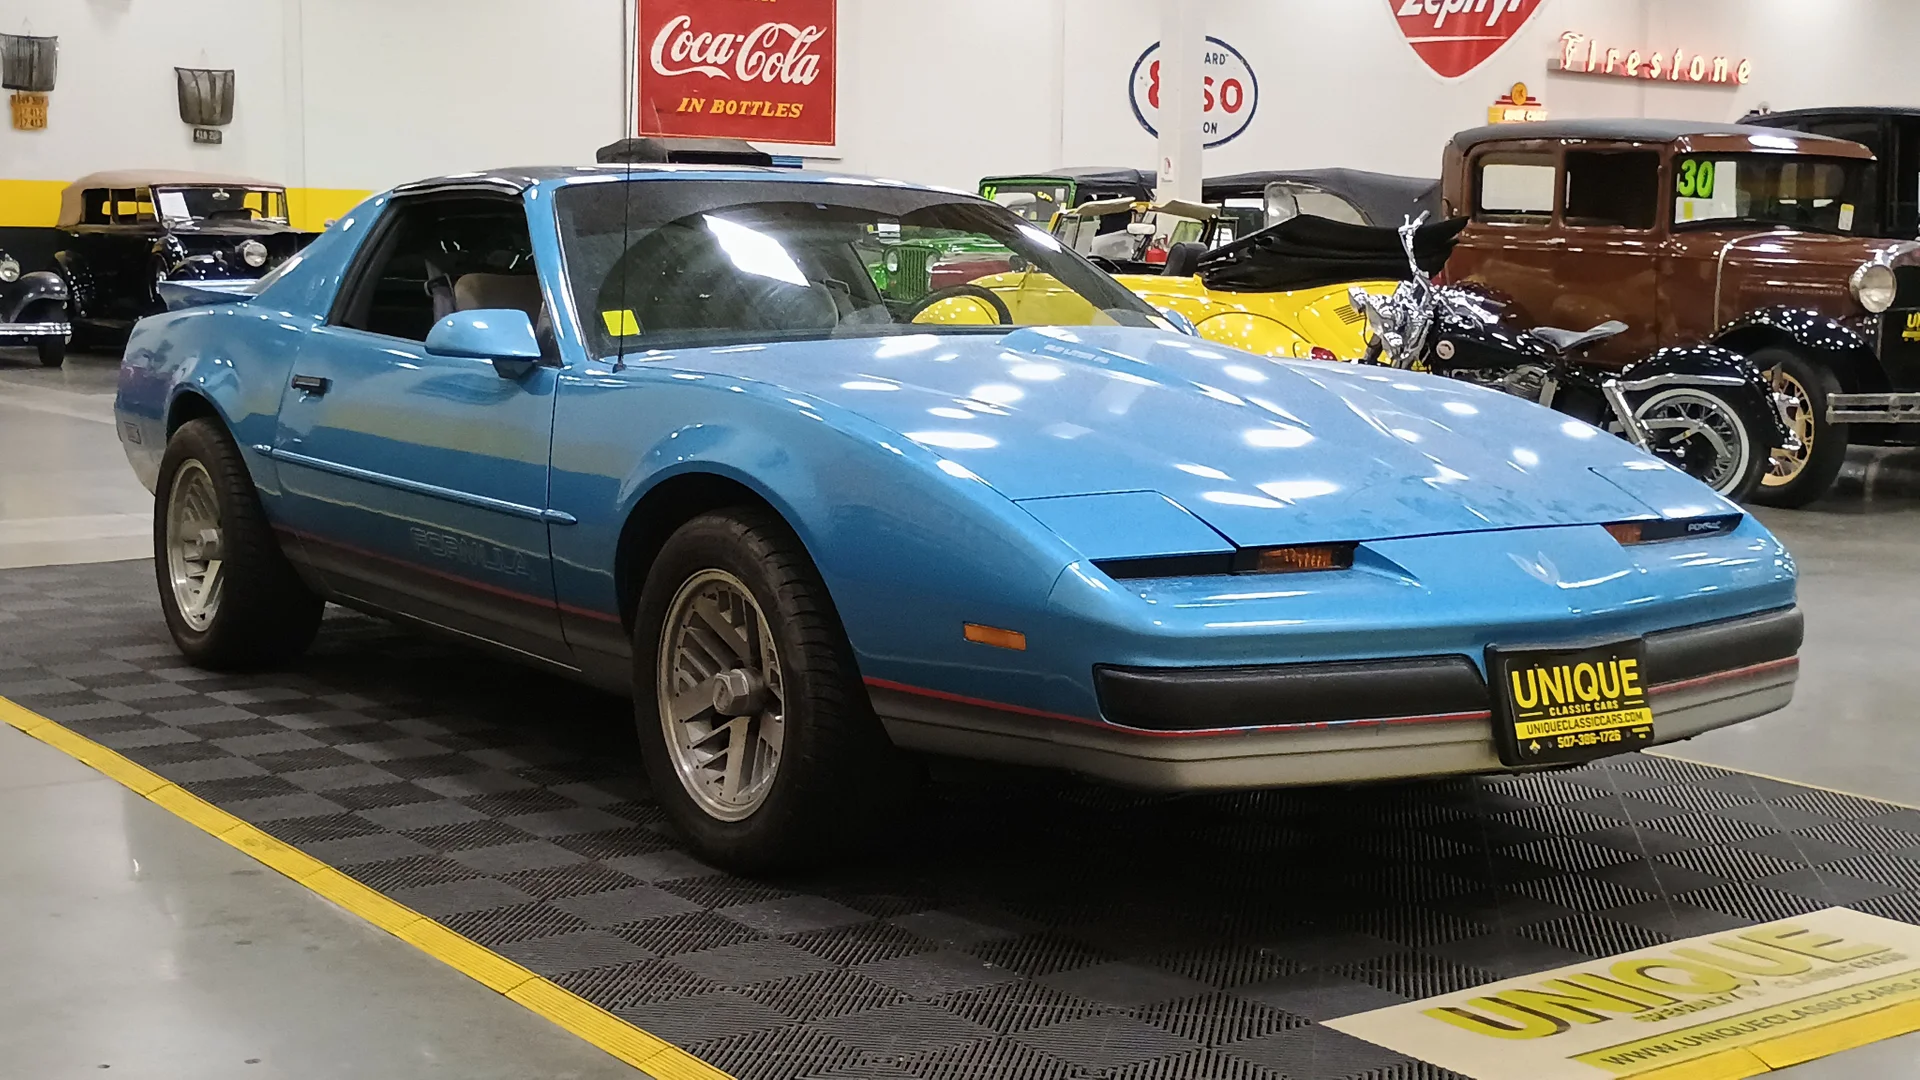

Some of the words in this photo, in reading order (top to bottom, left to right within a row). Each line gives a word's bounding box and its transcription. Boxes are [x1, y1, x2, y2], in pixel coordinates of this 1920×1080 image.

[651, 15, 827, 85] Coca-Cola
[1559, 31, 1751, 84] Firestone
[677, 98, 706, 113] IN
[710, 99, 803, 118] BOTTLES
[1679, 159, 1714, 198] 30
[1511, 659, 1643, 709] UNIQUE
[1526, 711, 1644, 735] UNIQUECLASSICCARS.COM
[1549, 703, 1592, 716] CLASSIC
[1594, 700, 1619, 711] CARS
[1423, 924, 1893, 1039] UNIQUE
